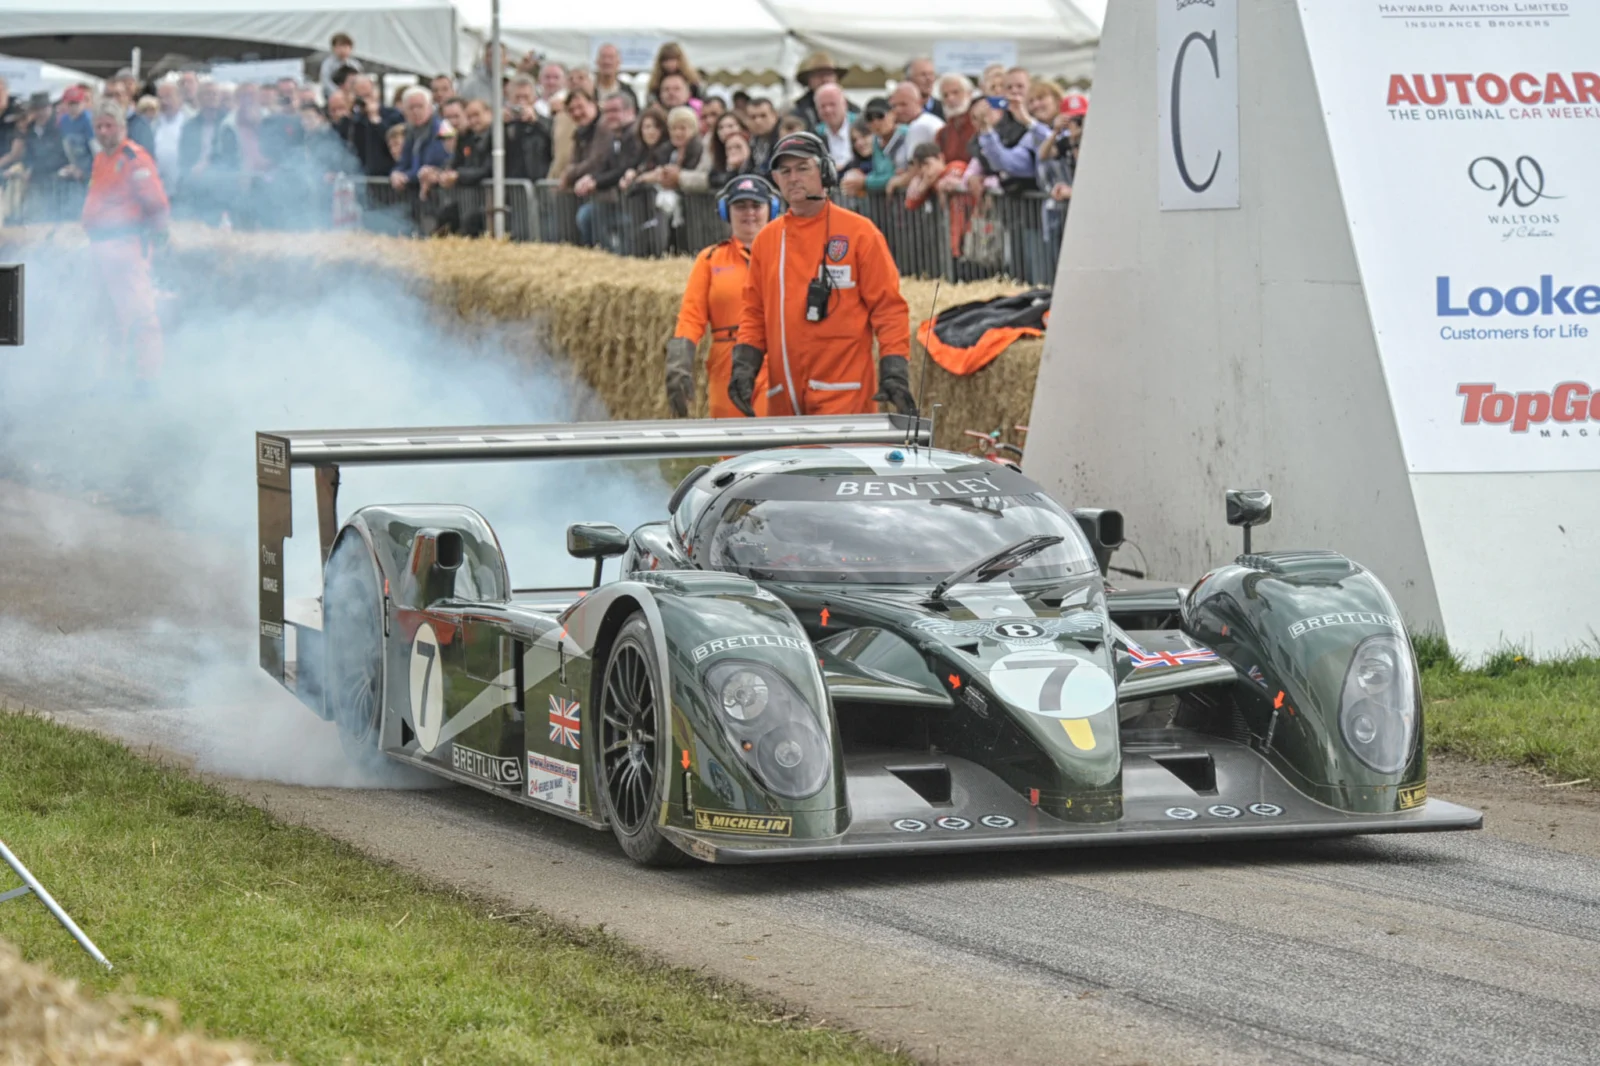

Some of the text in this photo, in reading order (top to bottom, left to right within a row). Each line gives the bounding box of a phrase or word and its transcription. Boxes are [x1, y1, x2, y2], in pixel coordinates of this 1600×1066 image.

[1379, 2, 1569, 14] HAYWARD AVIATION LIMITED
[1405, 19, 1550, 28] INSURANCE BROKERS
[1386, 72, 1600, 106] AUTOCAR
[1171, 29, 1221, 193] C
[1388, 109, 1421, 120] THE
[1425, 108, 1505, 120] ORIGINAL
[1509, 107, 1542, 119] CAR
[1488, 214, 1560, 224] WALTONS
[1436, 275, 1600, 317] Looke
[1440, 324, 1588, 340] Customers for Life
[1540, 428, 1600, 437] MAG
[836, 476, 1000, 497] BENTLEY
[416, 640, 436, 728] 7
[1002, 659, 1079, 711] 7
[453, 745, 521, 782] BREITLING
[711, 816, 787, 831] MICHELIN
